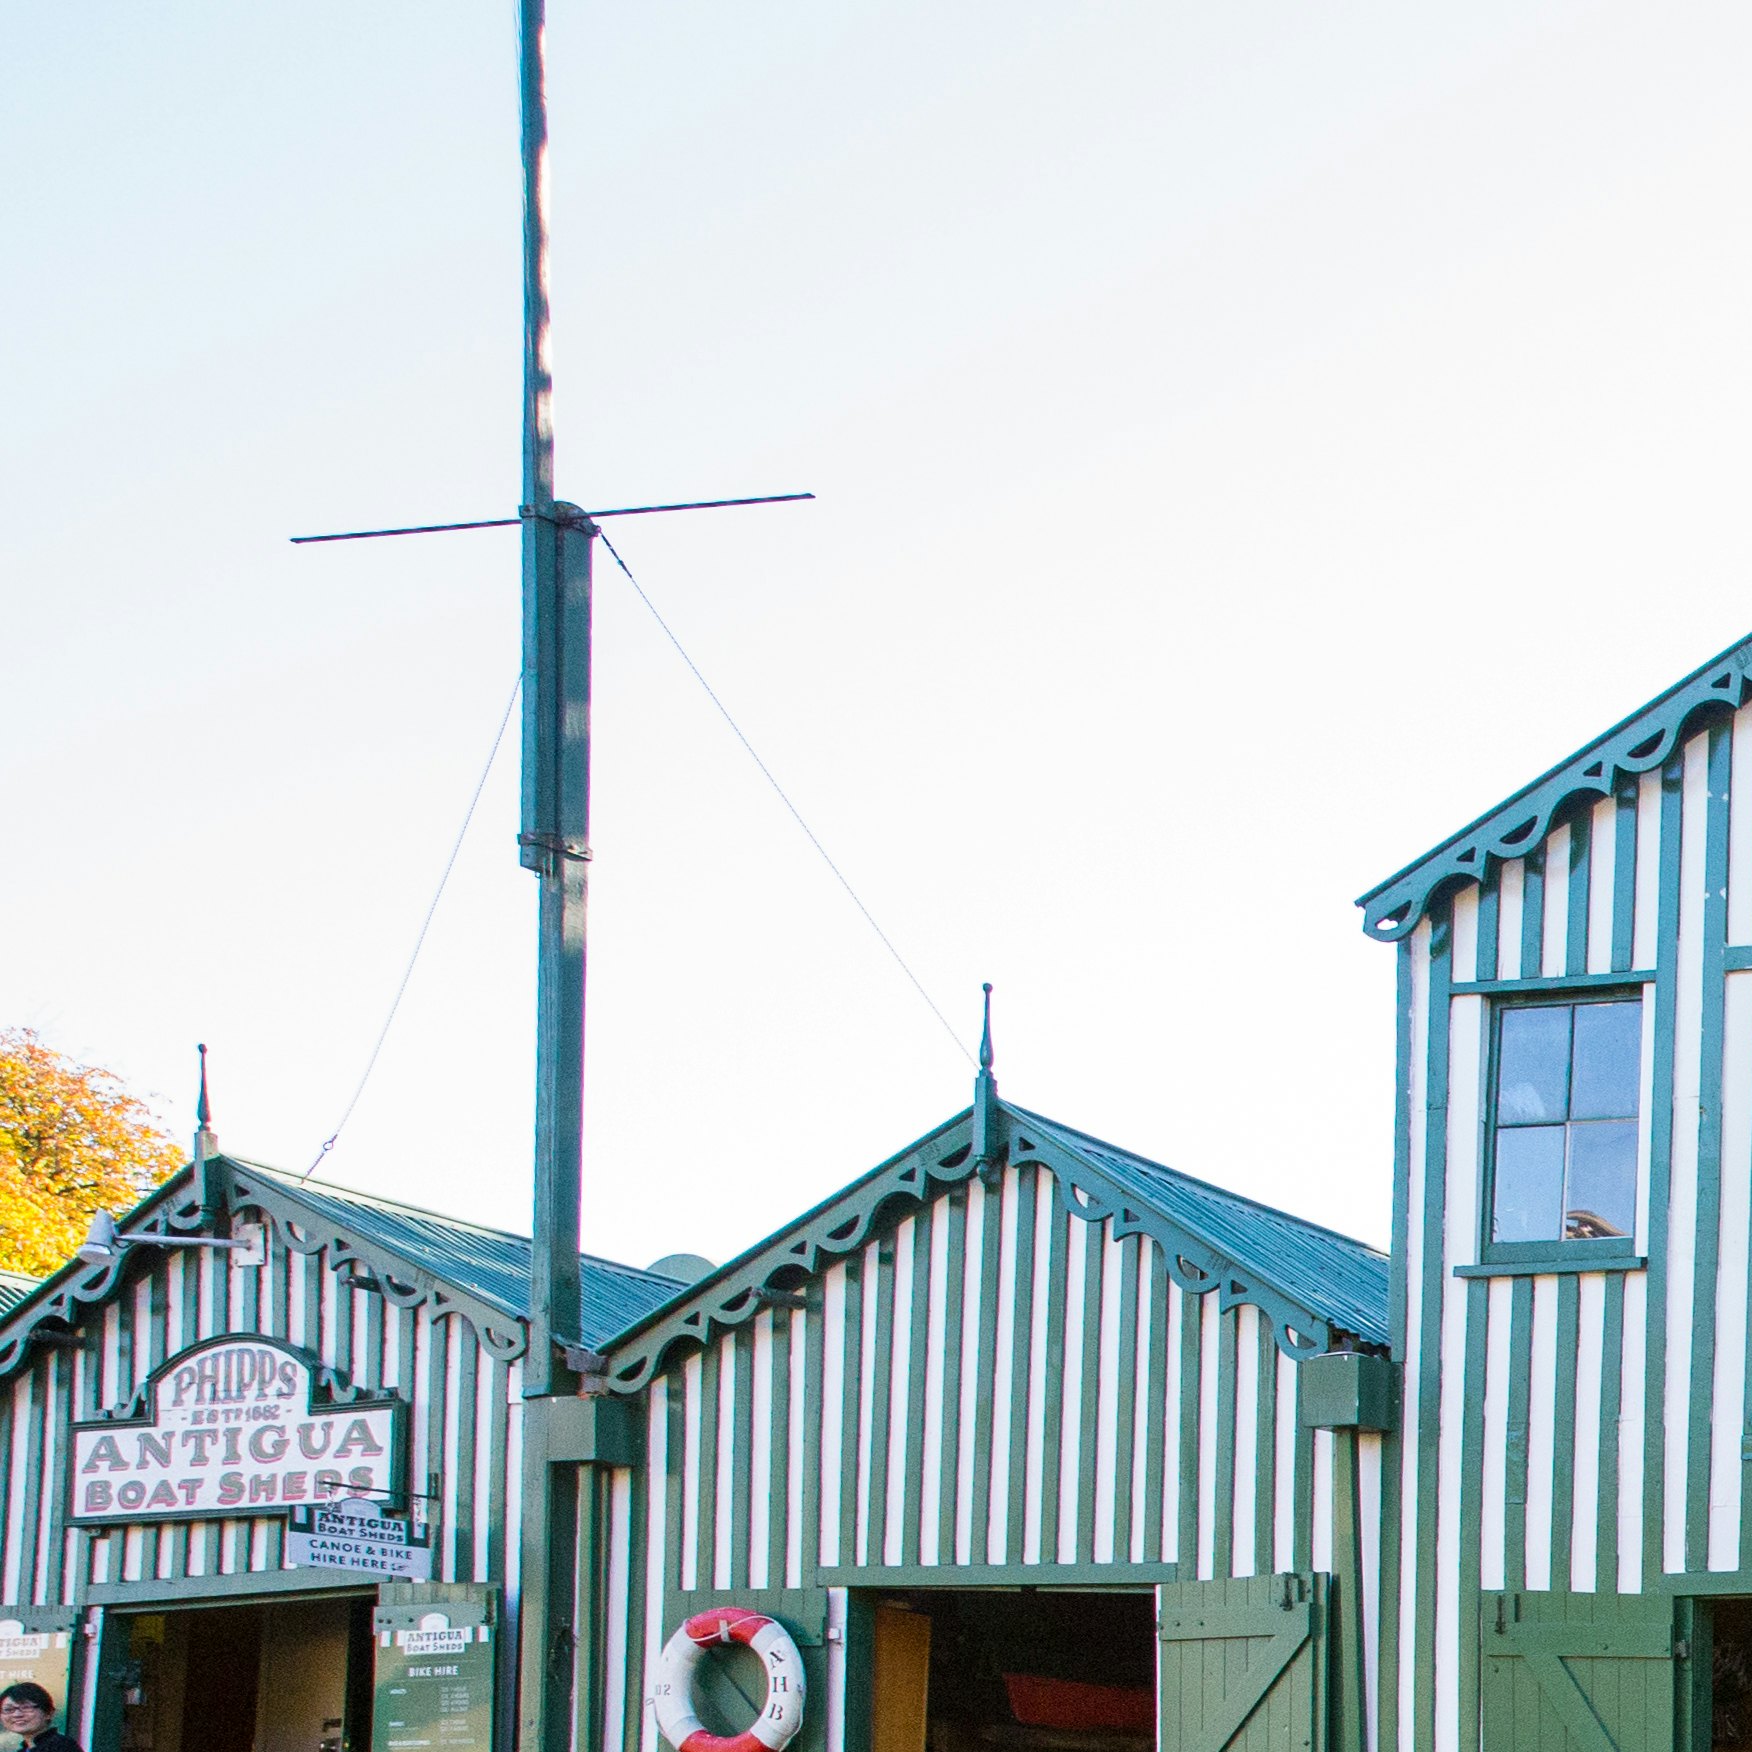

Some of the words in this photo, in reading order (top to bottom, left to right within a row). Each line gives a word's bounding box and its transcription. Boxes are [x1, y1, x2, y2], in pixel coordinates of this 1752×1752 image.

[172, 1348, 298, 1407] PHIPPS
[82, 1418, 384, 1474] ANTIGUA
[84, 1478, 204, 1513] BOAT
[217, 1466, 374, 1506] SHEDS
[319, 1512, 403, 1532] ANTIGUA
[319, 1523, 355, 1536] BOAT
[360, 1528, 404, 1542] SHEDS
[310, 1539, 361, 1554] CANOE
[366, 1546, 376, 1556] &
[381, 1547, 413, 1560] BIKE
[311, 1552, 346, 1565] HIRE
[351, 1556, 387, 1570] HERE
[407, 1630, 462, 1642] ANTIGUA
[407, 1643, 430, 1652] BOAT
[433, 1641, 463, 1651] SHEDS
[408, 1666, 431, 1677] BIKE
[434, 1665, 459, 1676] HIRE
